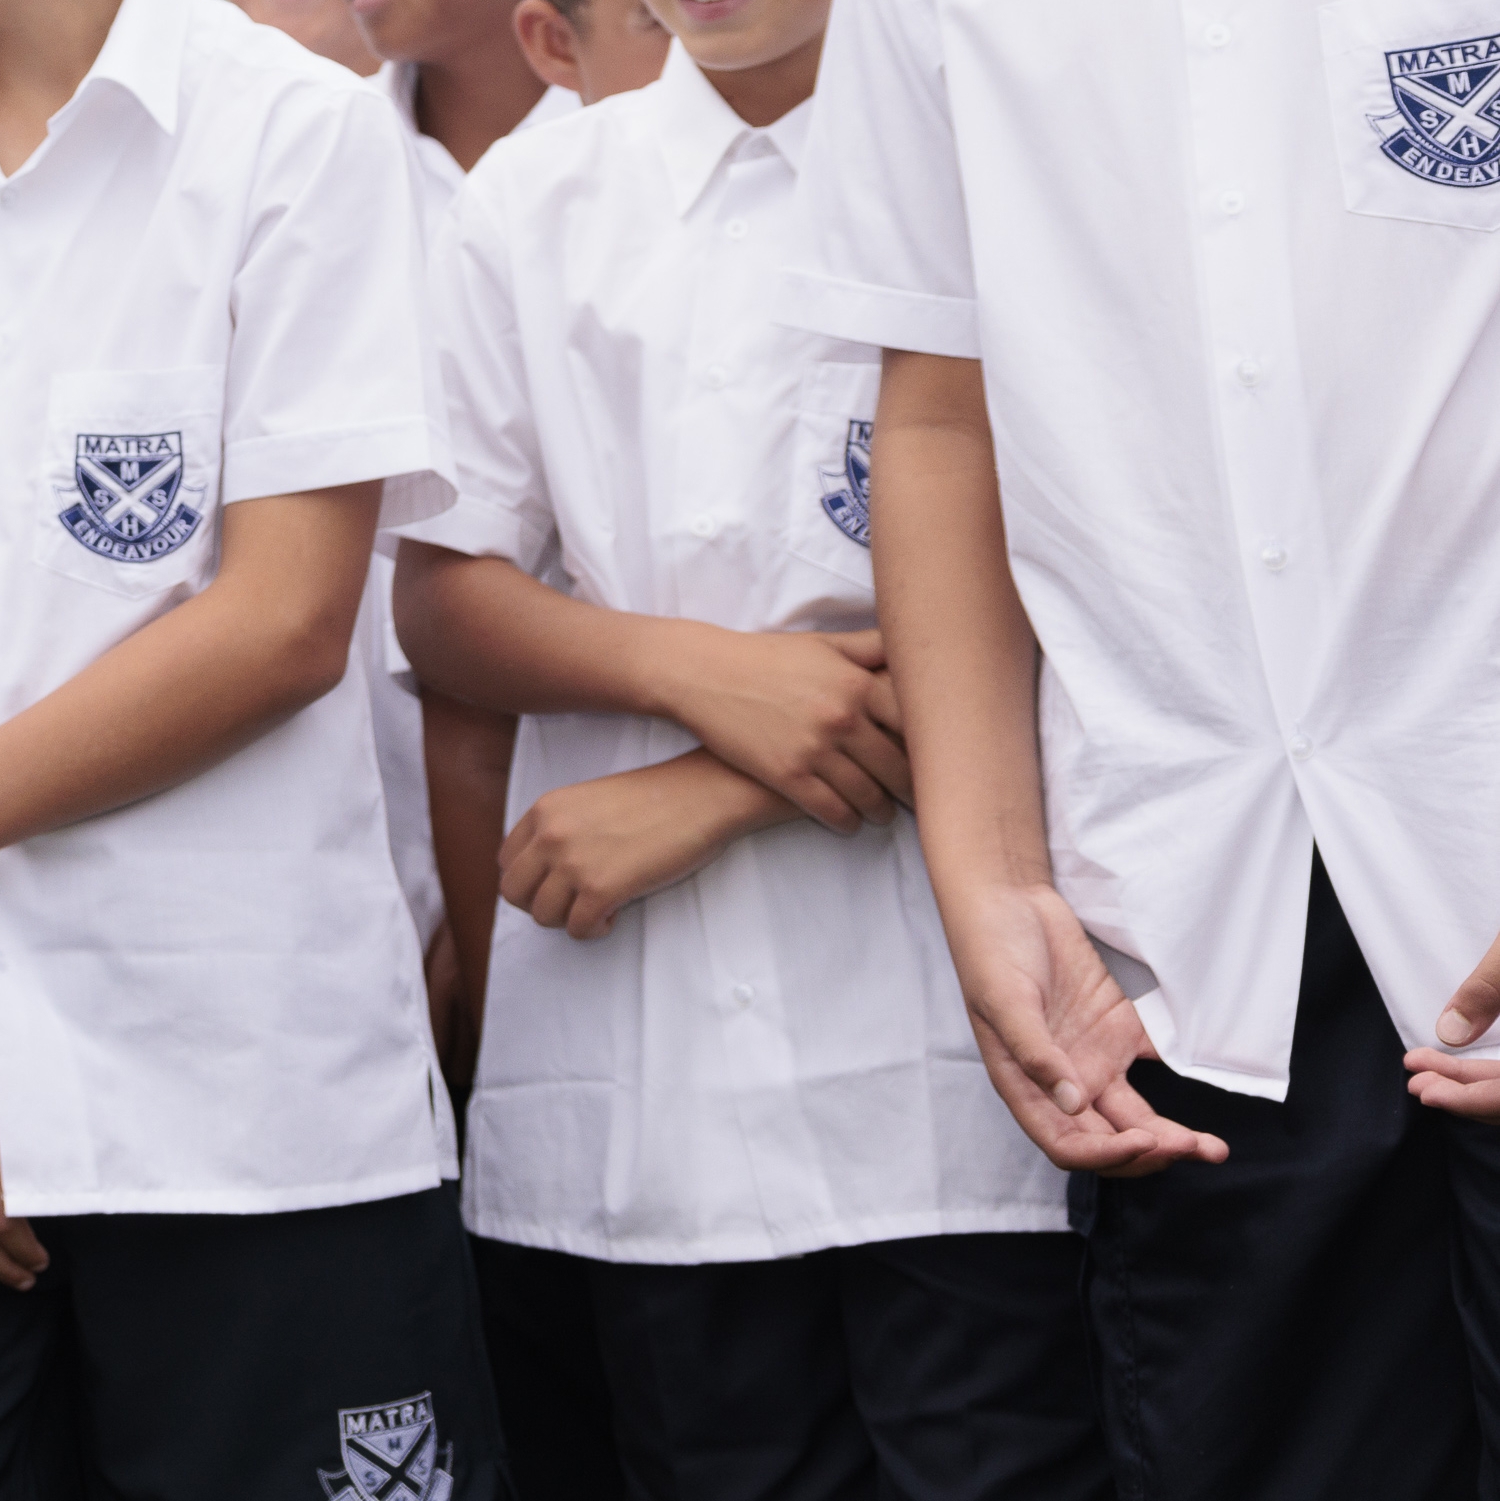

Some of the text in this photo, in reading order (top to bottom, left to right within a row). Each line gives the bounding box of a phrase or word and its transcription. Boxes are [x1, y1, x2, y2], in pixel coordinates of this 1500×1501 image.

[1446, 71, 1471, 94] M
[1419, 109, 1439, 129] S
[1459, 135, 1481, 157] H
[85, 436, 173, 454] MATRA
[120, 460, 140, 481] M
[93, 489, 168, 507] S S
[121, 516, 139, 537] H
[73, 518, 192, 559] ENDEAVOUR
[346, 1401, 430, 1435] MATRA
